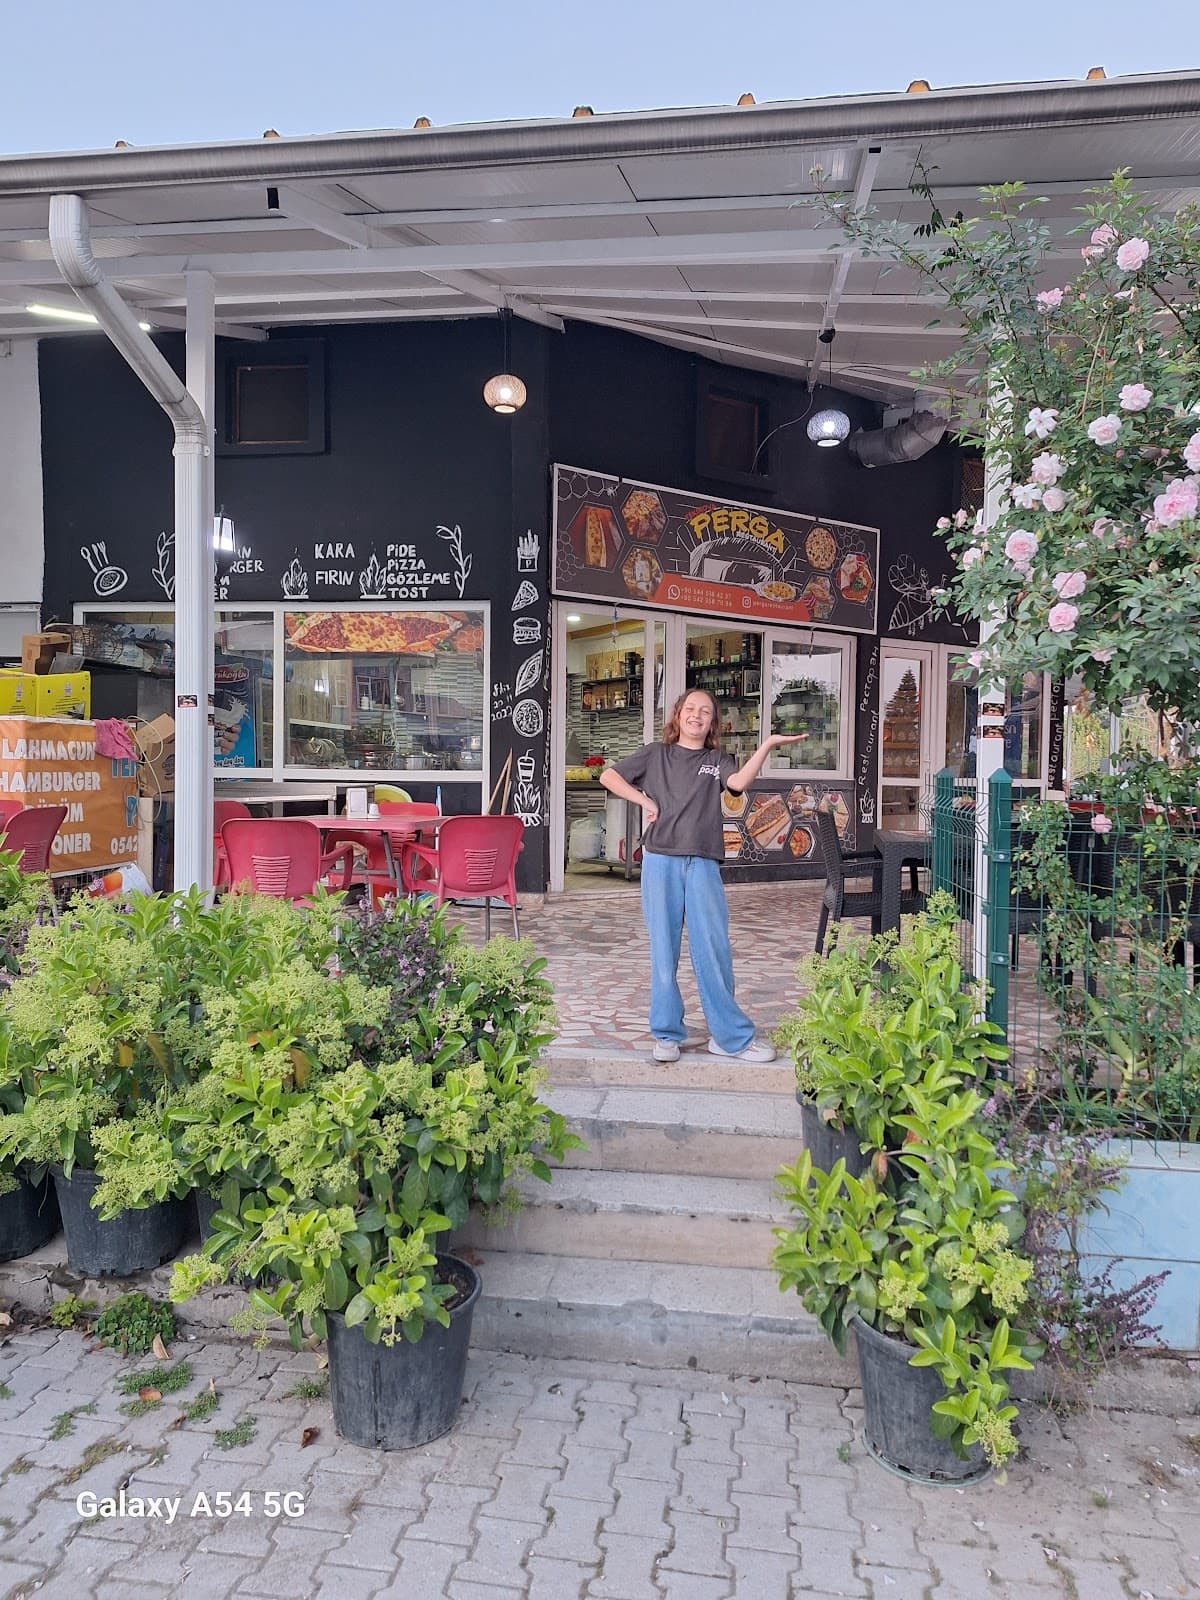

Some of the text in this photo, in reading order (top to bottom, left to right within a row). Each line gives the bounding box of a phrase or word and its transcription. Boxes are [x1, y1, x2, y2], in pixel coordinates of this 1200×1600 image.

[690, 509, 784, 554] PERGA
[314, 542, 355, 559] KARA
[230, 559, 265, 574] RGER
[315, 569, 354, 586] FIRIN
[386, 571, 450, 586] GÖZLEME
[388, 586, 429, 599] TOST
[2, 739, 96, 760] LAHMACUN
[858, 709, 879, 786] Restaurant
[0, 771, 100, 793] HAMBURGER
[51, 830, 91, 856] ÖNER
